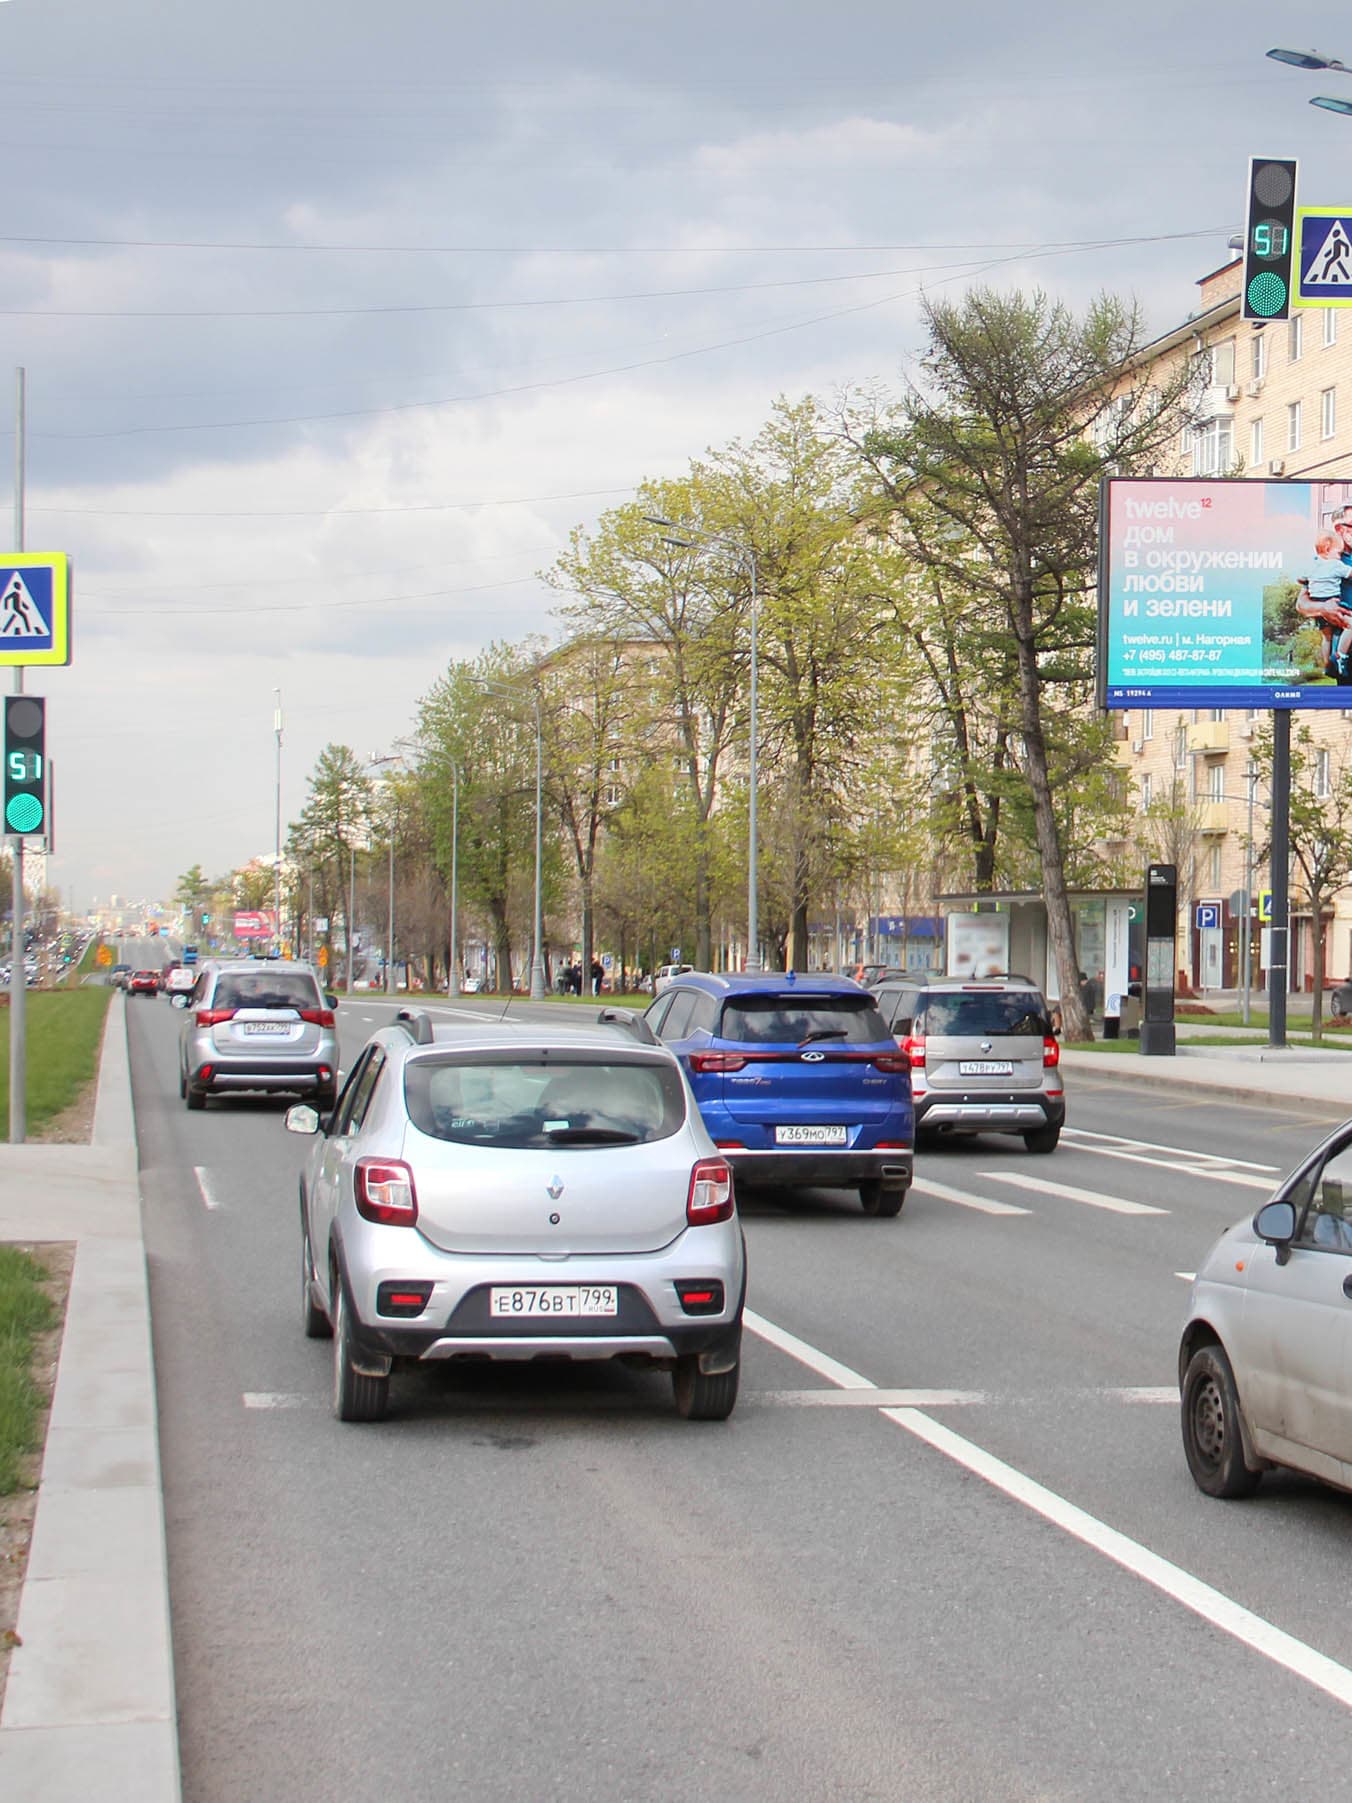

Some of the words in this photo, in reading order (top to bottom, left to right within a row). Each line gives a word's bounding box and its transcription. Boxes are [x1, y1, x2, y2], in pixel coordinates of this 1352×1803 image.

[1255, 225, 1287, 255] 51
[1124, 497, 1200, 519] twelve
[1123, 526, 1174, 548] дом
[1124, 551, 1138, 568] в
[1146, 551, 1283, 573] окружении
[1123, 571, 1204, 592] любви
[1123, 599, 1138, 617] и
[1146, 599, 1232, 617] зелени
[1122, 634, 1172, 645] twelve.ru
[1196, 634, 1251, 646] Нагорная
[1122, 650, 1136, 660] +7
[1139, 650, 1166, 662] (495)
[1169, 650, 1222, 661] 487-87-87
[10, 752, 42, 780] 51
